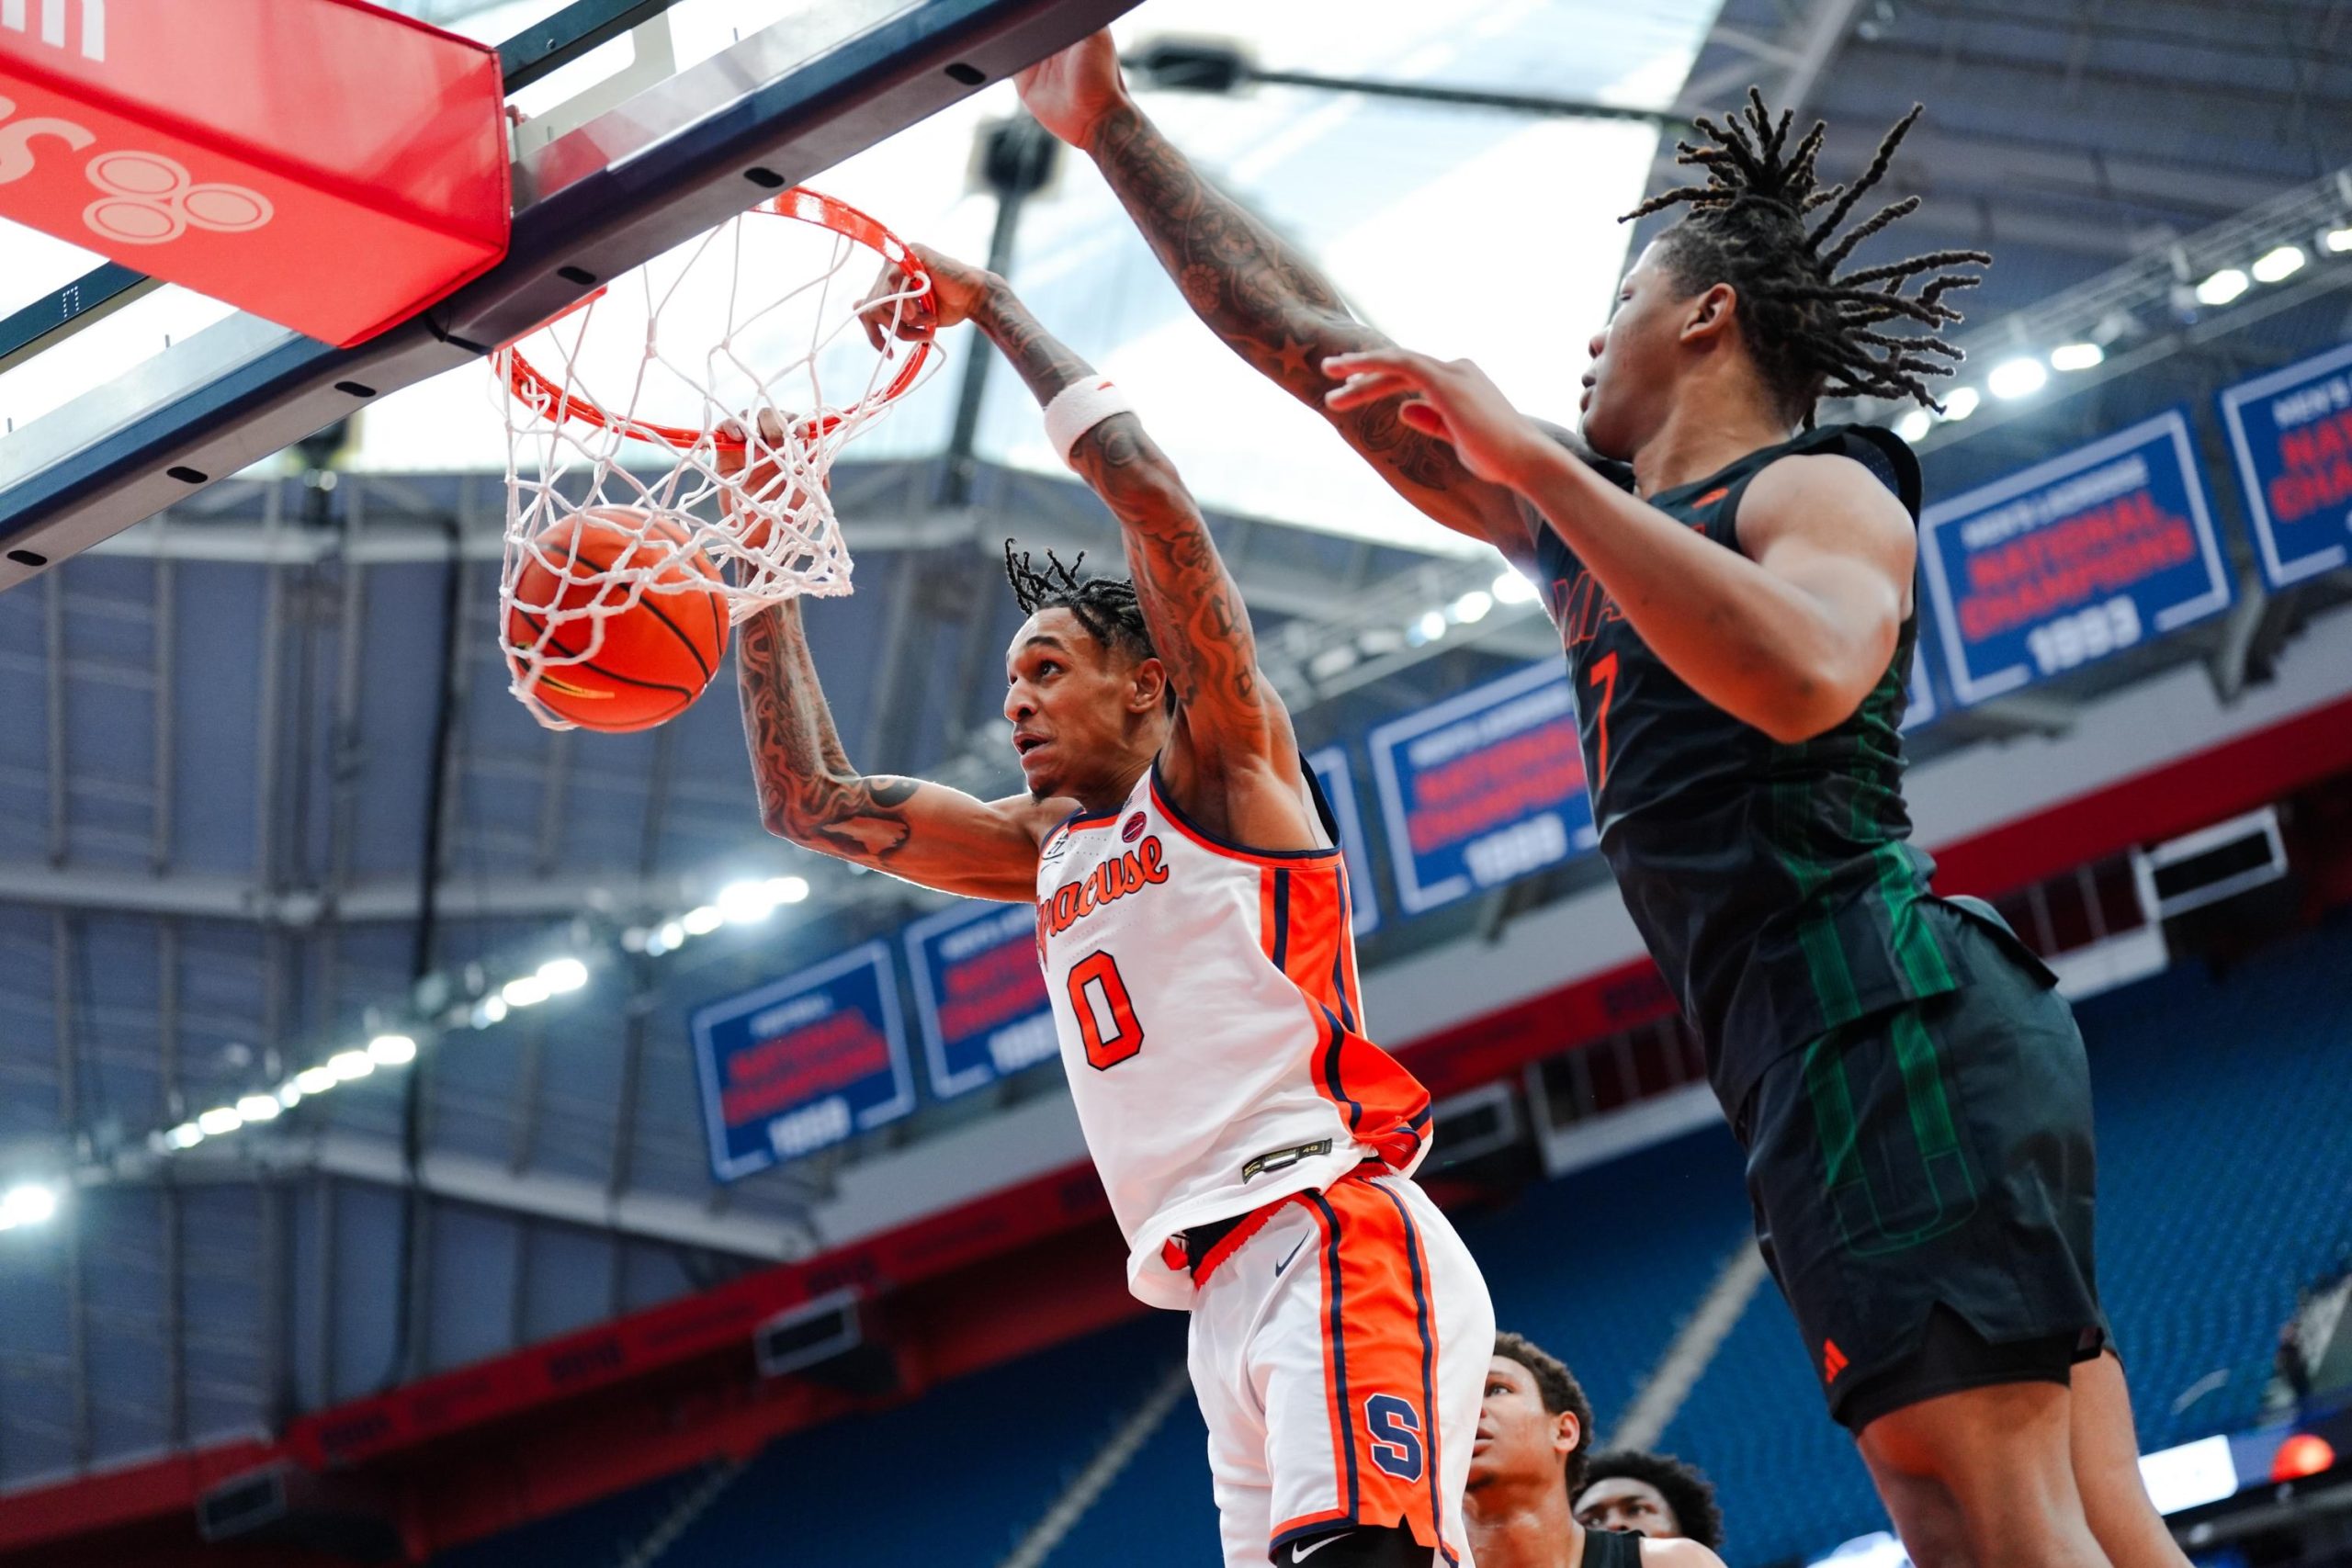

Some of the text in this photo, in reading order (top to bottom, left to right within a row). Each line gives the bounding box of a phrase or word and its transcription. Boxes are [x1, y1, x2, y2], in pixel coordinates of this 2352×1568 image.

[1590, 650, 1618, 791] 7
[1067, 949, 1144, 1071] 0
[1363, 1393, 1422, 1483] S
